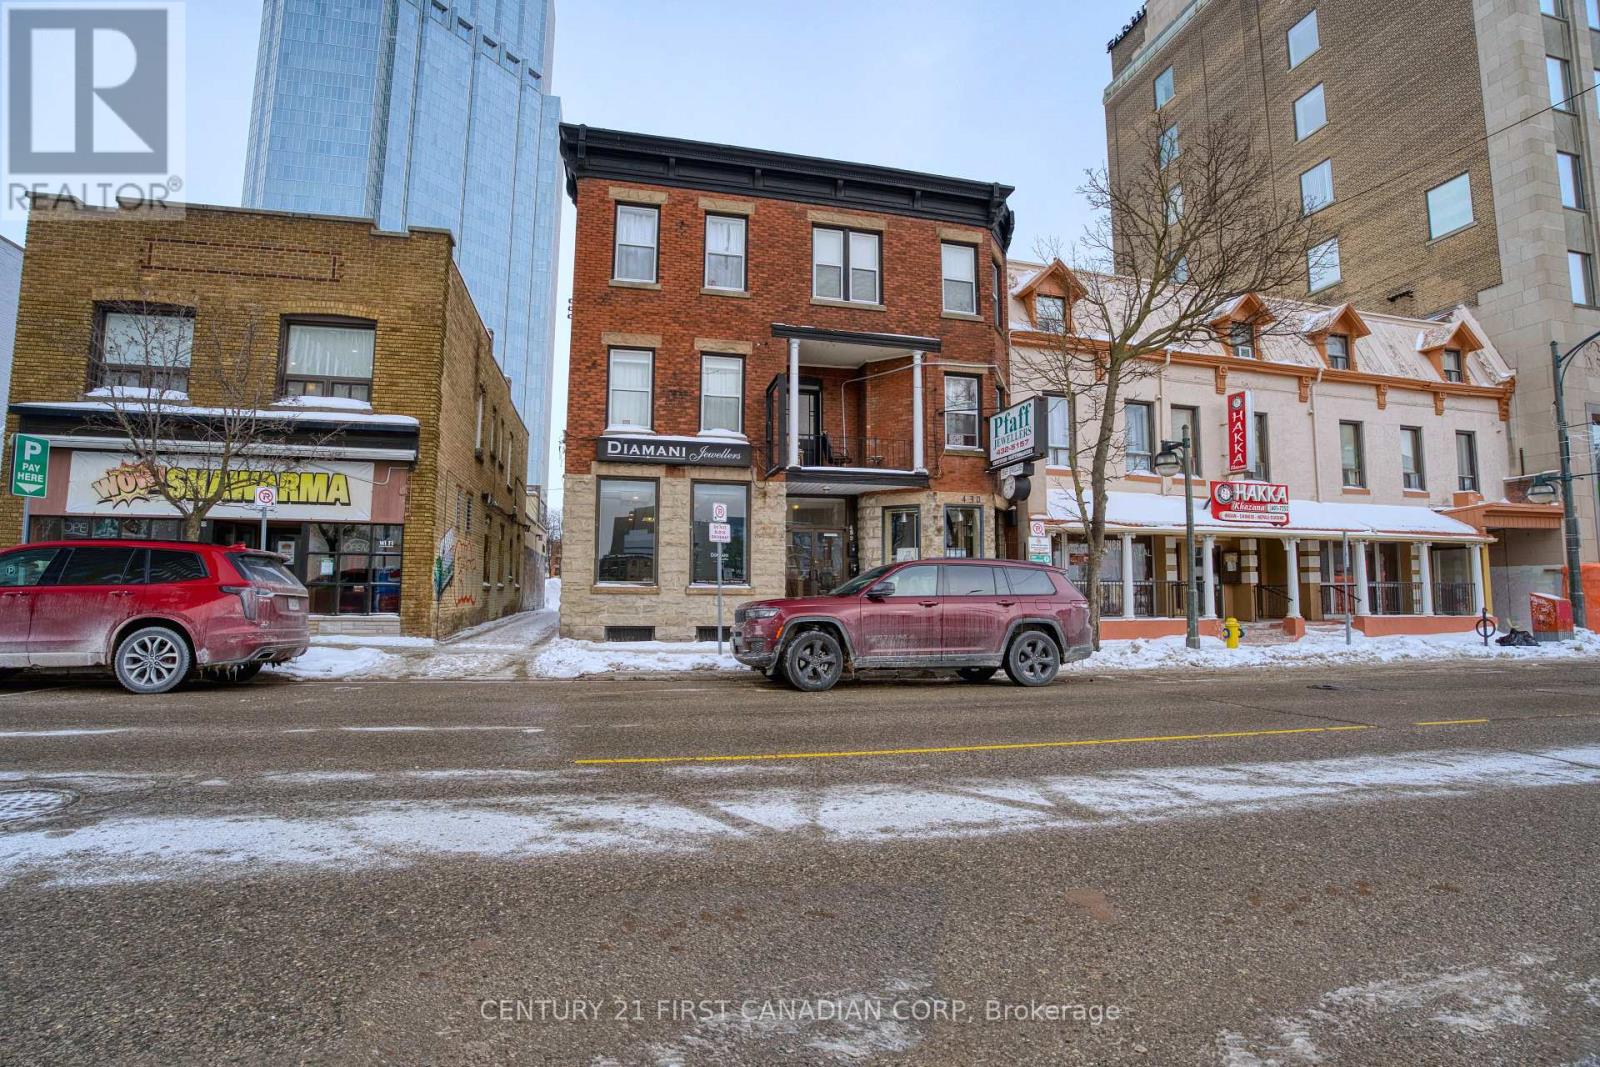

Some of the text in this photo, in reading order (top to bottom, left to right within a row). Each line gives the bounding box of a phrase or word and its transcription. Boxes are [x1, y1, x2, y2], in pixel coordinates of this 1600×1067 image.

[993, 402, 1032, 438] Pfaff
[994, 425, 1032, 450] JEWELLERS
[1232, 410, 1244, 465] HAKKA
[24, 440, 42, 460] P
[607, 440, 741, 462] DIAMANI Jewellers
[17, 471, 44, 483] HERE
[22, 462, 41, 473] PAY
[1233, 483, 1288, 503] HAKKA
[1234, 502, 1265, 511] Khazana
